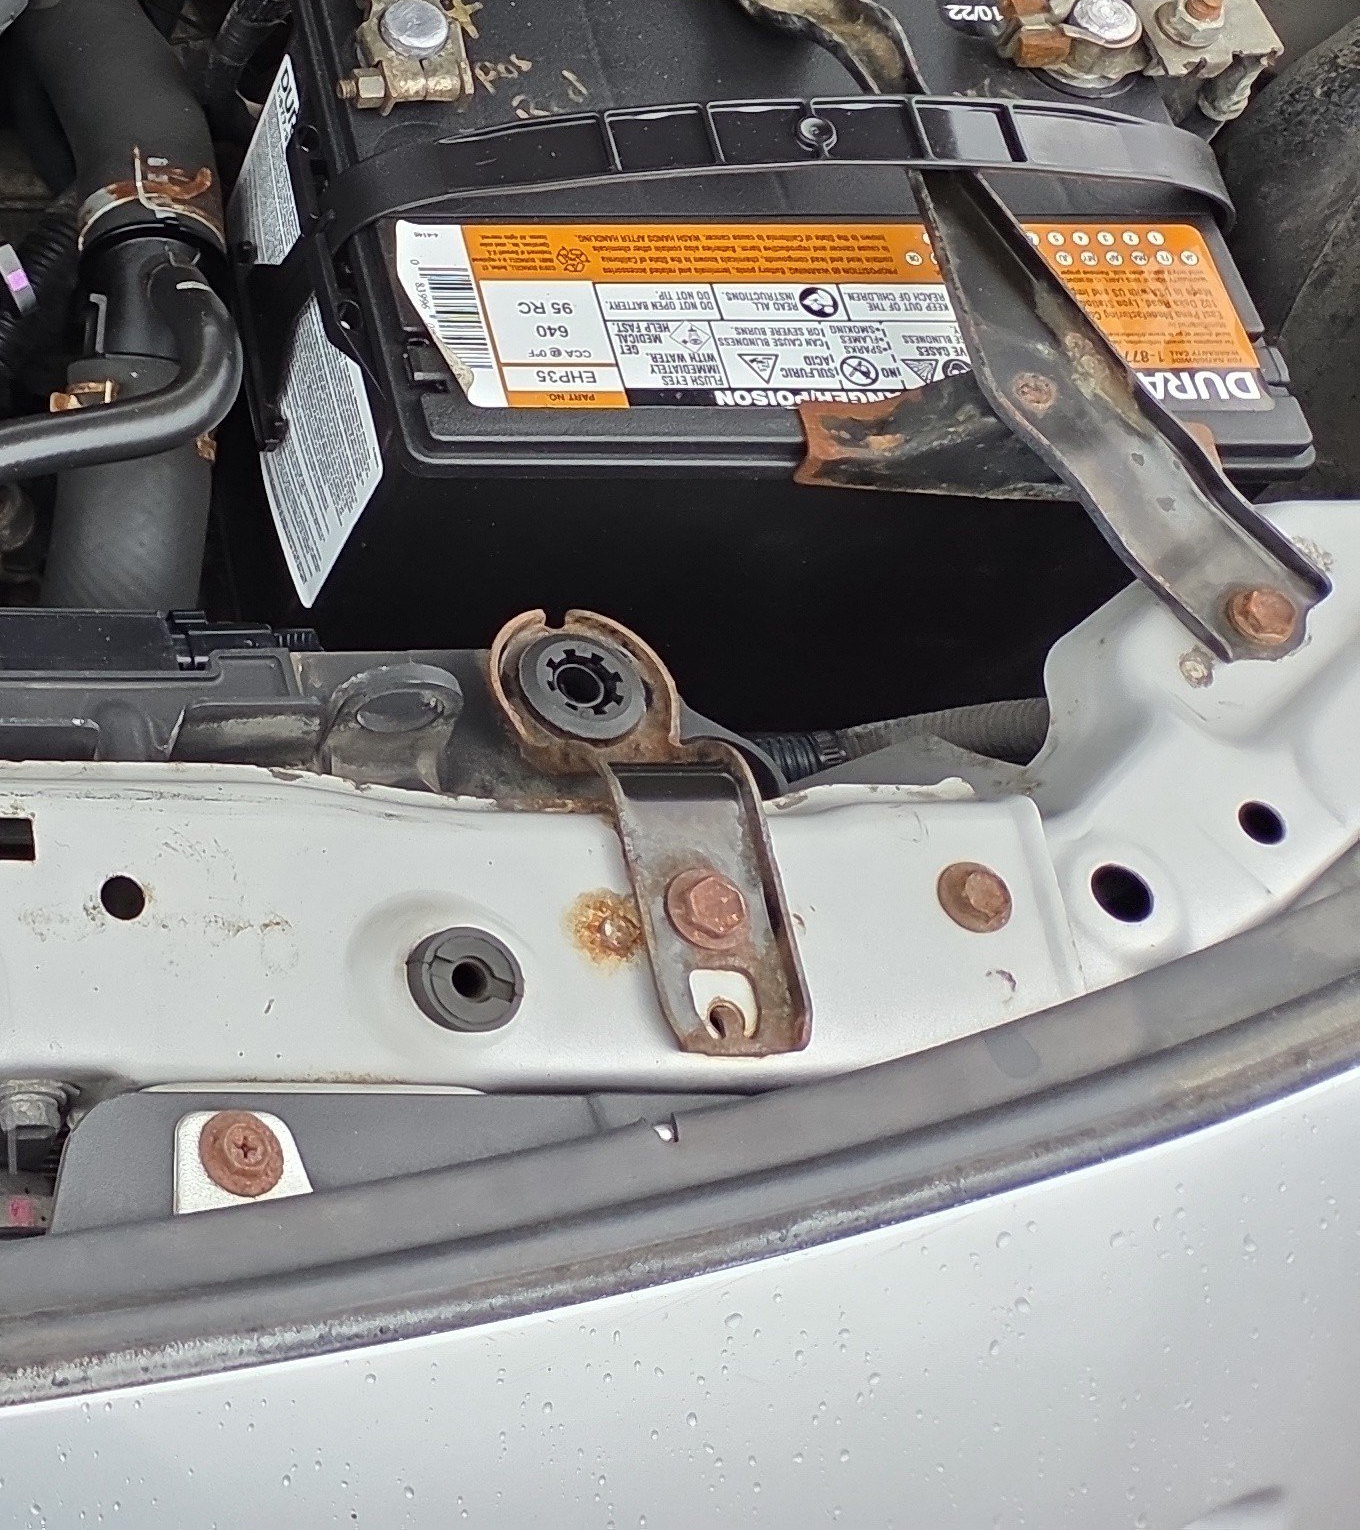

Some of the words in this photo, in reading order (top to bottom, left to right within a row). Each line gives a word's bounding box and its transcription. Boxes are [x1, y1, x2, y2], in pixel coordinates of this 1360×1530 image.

[944, 3, 1004, 21] 10/22
[655, 291, 674, 300] TIP.
[676, 291, 695, 300] NOT
[698, 291, 710, 300] DO
[722, 291, 795, 301] INSTRUCTIONS.
[844, 292, 897, 302] CHILDREN.
[900, 293, 912, 302] OF
[915, 293, 944, 302] REACH
[1112, 289, 1126, 297] US
[518, 302, 545, 314] RC
[550, 302, 573, 314] 95
[605, 301, 648, 310] BATTERY.
[650, 301, 675, 310] OPEN
[677, 301, 697, 310] NOT
[700, 301, 713, 310] DO
[752, 302, 770, 310] ALL
[773, 302, 798, 310] READ
[866, 302, 886, 311] THE
[888, 302, 900, 311] OF
[902, 302, 922, 311] OUT
[923, 302, 948, 311] KEEP
[536, 325, 569, 338] 640
[612, 322, 642, 333] FAST.
[644, 322, 670, 333] HELP
[730, 326, 767, 336] BURNS.
[770, 327, 804, 336] SEVERE
[806, 327, 820, 336] OR
[615, 334, 662, 344] MEDICAL
[718, 337, 770, 347] BLINDNESS
[772, 338, 802, 347] CAUSE
[804, 338, 823, 347] CAN
[902, 335, 952, 344] BLINDNESS
[549, 348, 562, 358] @
[565, 349, 592, 358] CCA
[620, 344, 639, 354] GET
[916, 346, 950, 356] GASES
[646, 353, 688, 362] WATER.
[690, 353, 716, 363] WITH
[803, 356, 830, 366] ACID
[1125, 351, 1164, 363] 1-877
[650, 364, 720, 375] IMMEDIATELY
[780, 367, 834, 378] SULFURIC
[536, 370, 596, 384] EHP35
[662, 375, 688, 385] EYES
[690, 376, 722, 386] FLUSH
[1134, 370, 1261, 400] DURA
[546, 393, 565, 401] NO.
[568, 393, 595, 401] PART
[714, 389, 902, 406] ANGER/POISON
